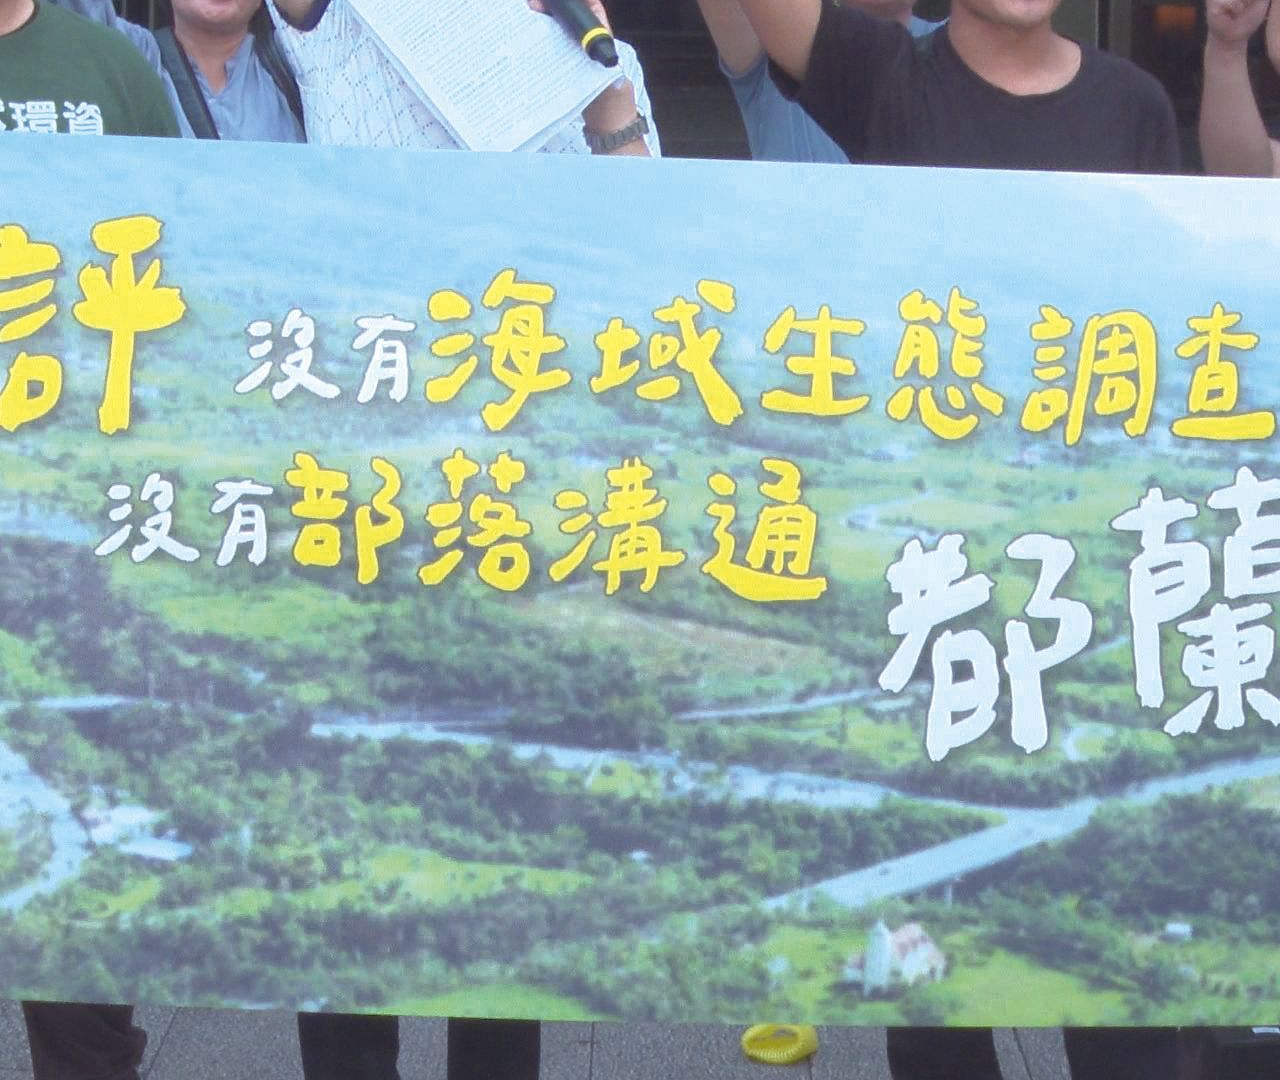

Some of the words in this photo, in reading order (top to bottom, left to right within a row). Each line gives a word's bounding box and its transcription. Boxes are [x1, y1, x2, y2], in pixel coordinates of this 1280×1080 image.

[234, 267, 1277, 446] 沒有海域生態調查
[93, 447, 829, 604] 沒有部落溝通
